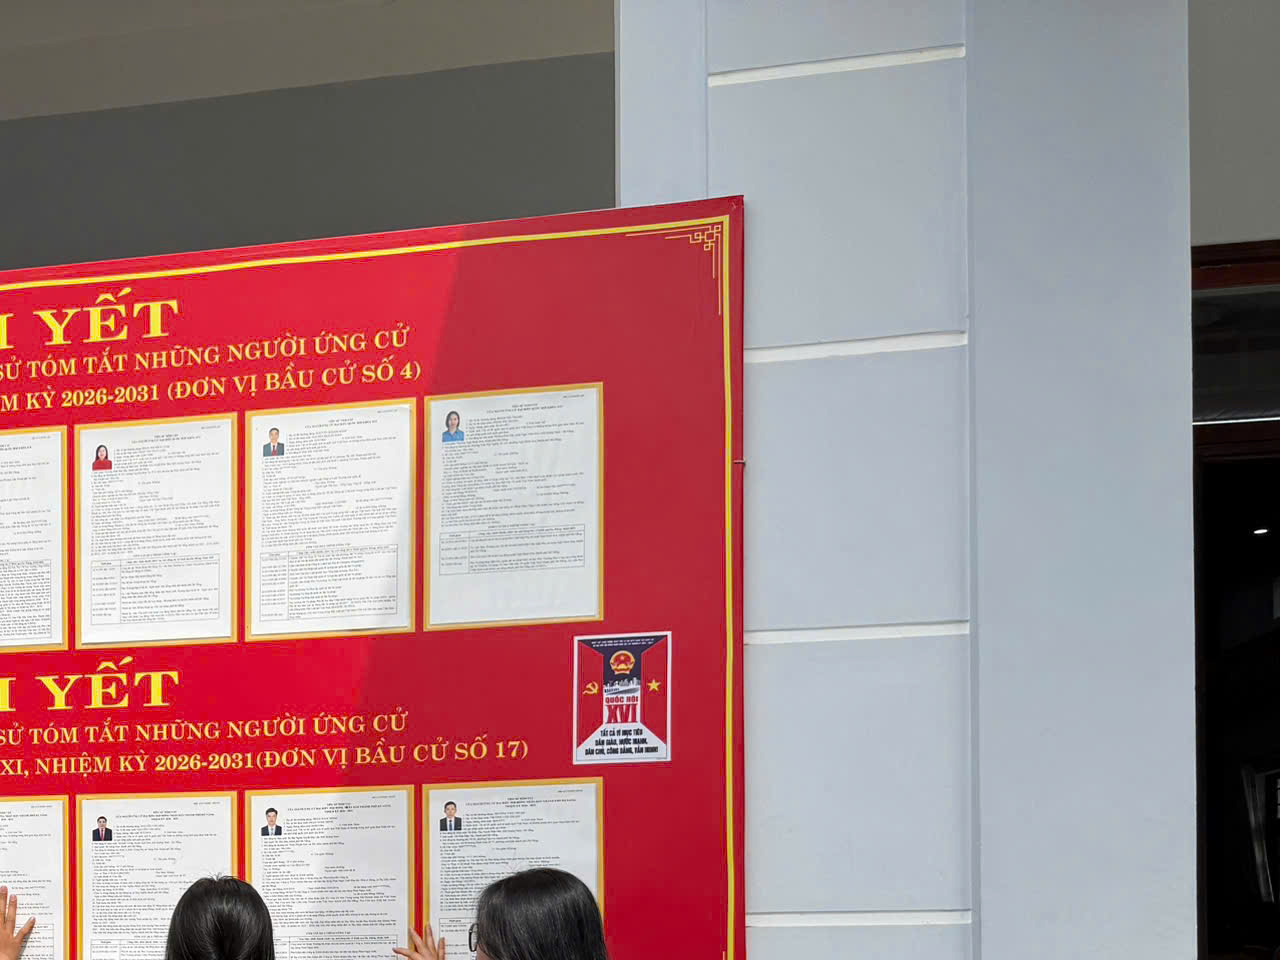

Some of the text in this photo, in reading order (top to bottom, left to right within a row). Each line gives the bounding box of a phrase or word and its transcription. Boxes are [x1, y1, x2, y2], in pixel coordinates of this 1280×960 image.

[33, 287, 178, 345] YẾT
[27, 354, 76, 378] TÓM
[83, 347, 128, 374] TẮT
[134, 345, 220, 370] NHỮNG
[227, 332, 306, 362] NGƯỜI
[313, 331, 368, 354] ỨNG
[374, 323, 410, 349] CỬ
[26, 385, 56, 409] KỲ
[62, 384, 159, 407] 2026-2031
[168, 376, 226, 400] (ĐƠN
[232, 375, 257, 396] VỊ
[265, 362, 314, 390] BẦU
[322, 360, 357, 386] CỬ
[362, 355, 394, 382] SỐ
[400, 361, 421, 380] 4)
[35, 656, 179, 710] YẾT
[29, 723, 78, 744] TÓM
[85, 718, 128, 742] TẮT
[136, 720, 220, 741] NHỮNG
[227, 713, 305, 738] NGƯỜI
[313, 712, 364, 734] ỨNG
[373, 707, 408, 732] CỬ
[605, 704, 639, 724] XVI
[0, 759, 28, 778] XI,
[36, 752, 111, 777] NHIỆM
[120, 750, 149, 771] KỲ
[323, 748, 347, 768] VỊ
[355, 738, 405, 763] BẦU
[414, 737, 449, 761] CỬ
[455, 735, 487, 760] SỐ
[496, 741, 528, 758] 17)
